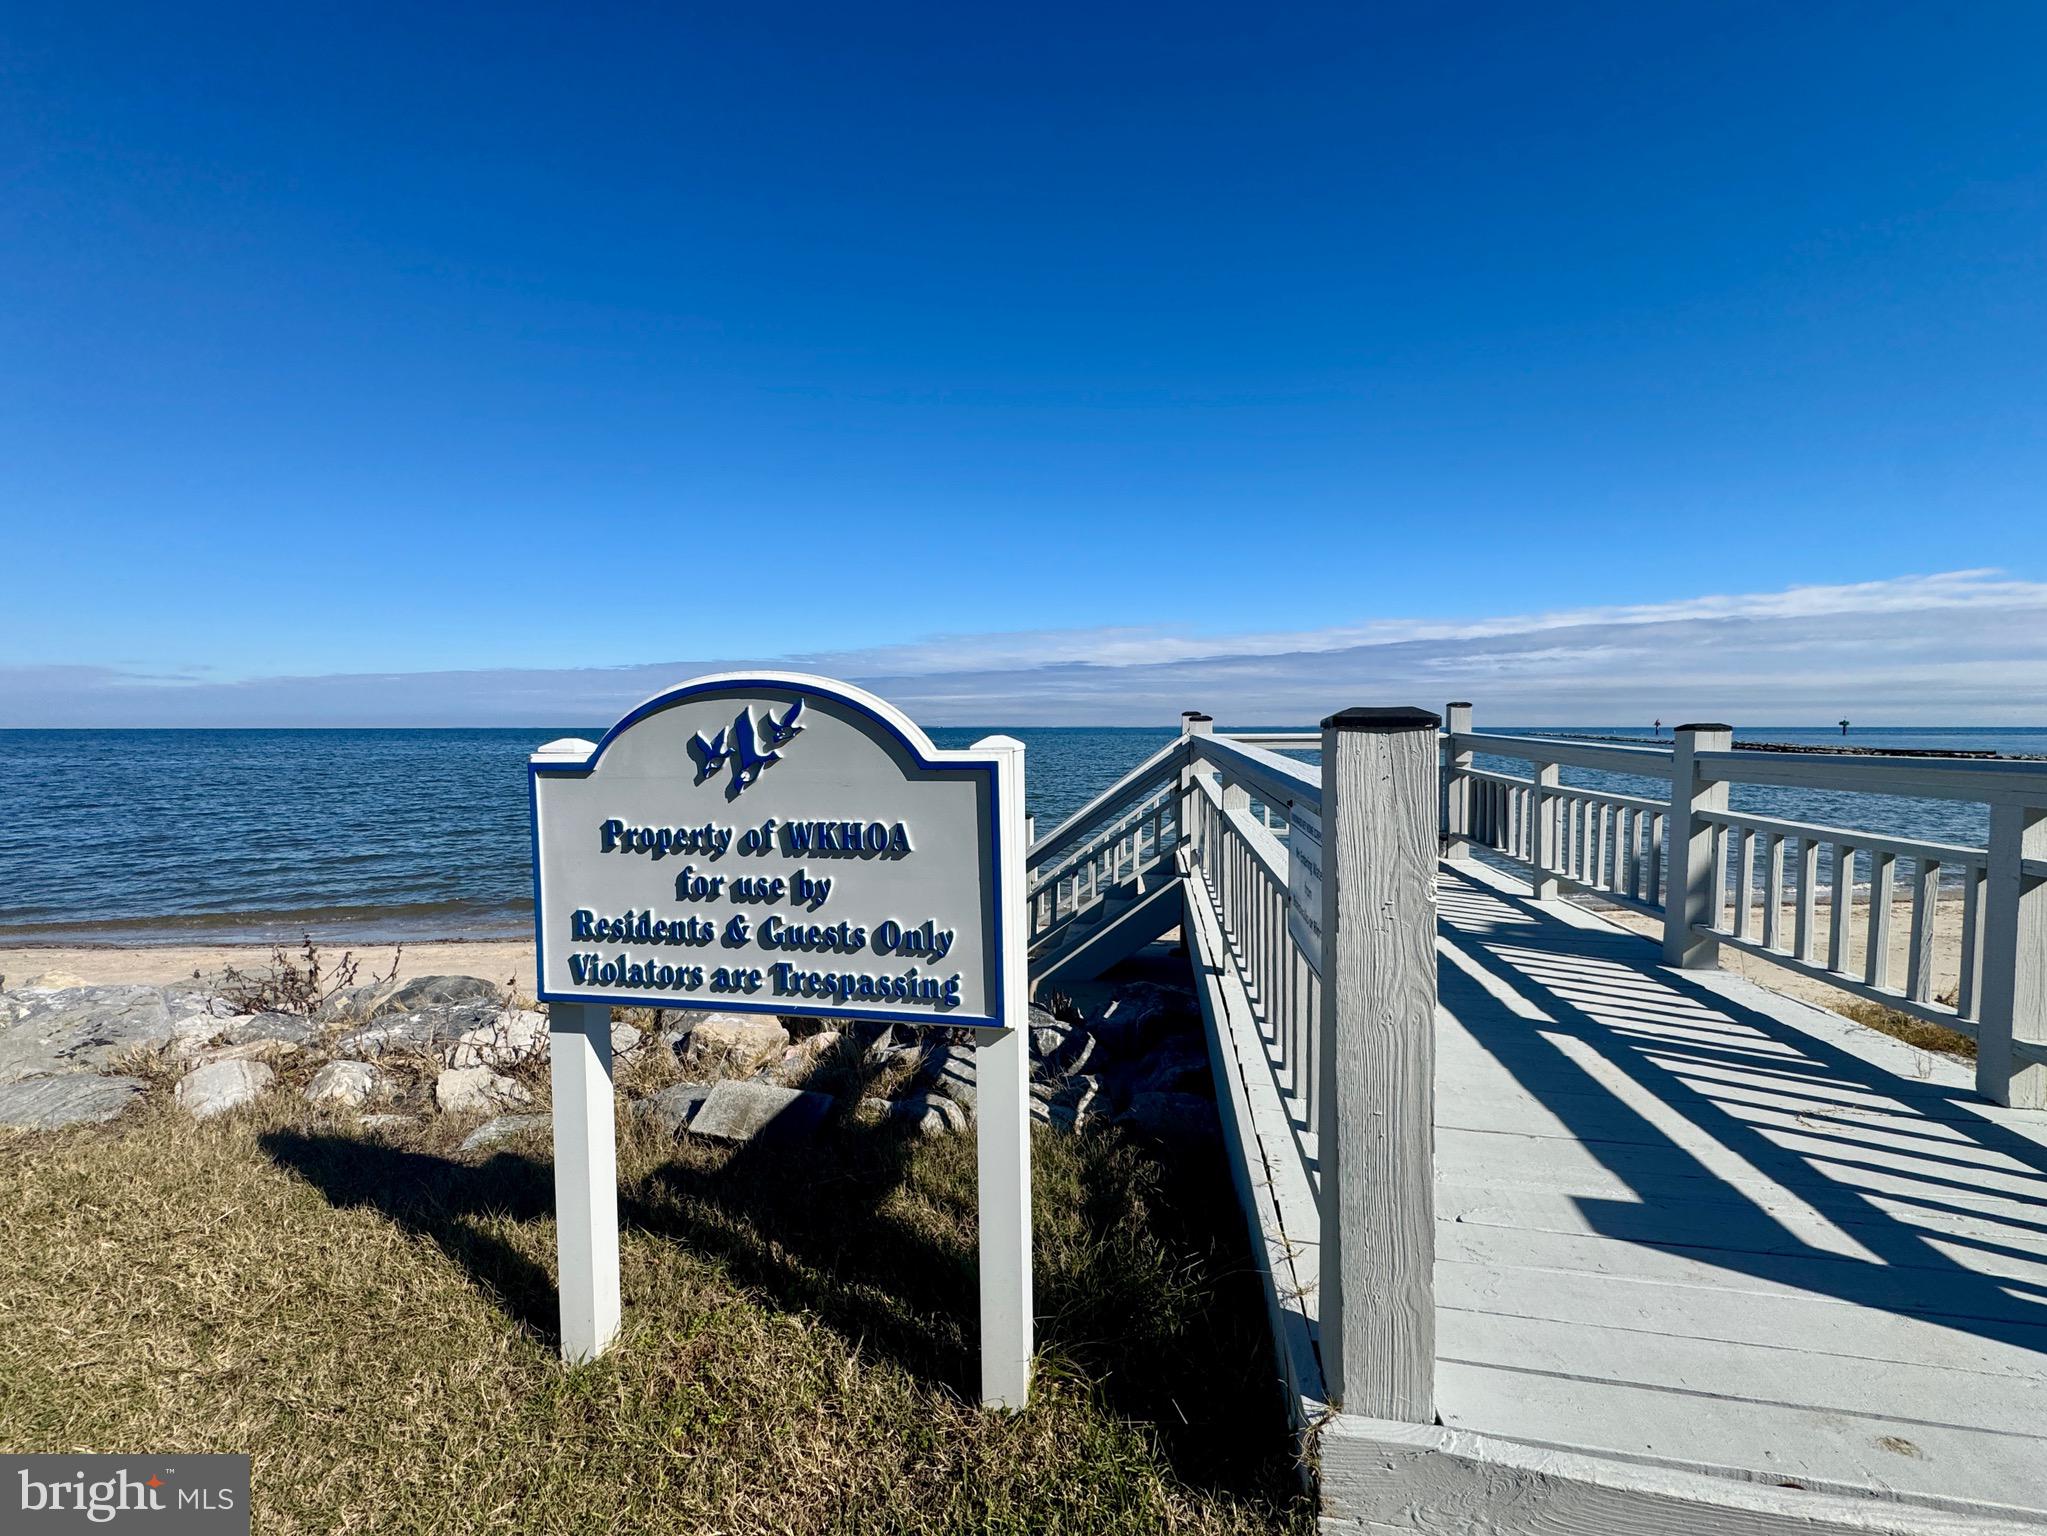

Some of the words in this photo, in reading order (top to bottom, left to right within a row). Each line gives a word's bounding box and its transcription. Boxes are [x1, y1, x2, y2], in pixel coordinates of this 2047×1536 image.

[602, 818, 735, 859] Property
[741, 817, 780, 854] of
[781, 819, 914, 857] WKHOA
[678, 864, 727, 900] for
[732, 873, 788, 901] use
[793, 867, 834, 909] by
[573, 909, 716, 943] Residents
[725, 914, 752, 947] &
[760, 916, 867, 951] Guests
[875, 919, 955, 960] Only
[569, 953, 705, 988] Violators
[712, 966, 765, 991] are
[771, 961, 962, 1005] Trespassing
